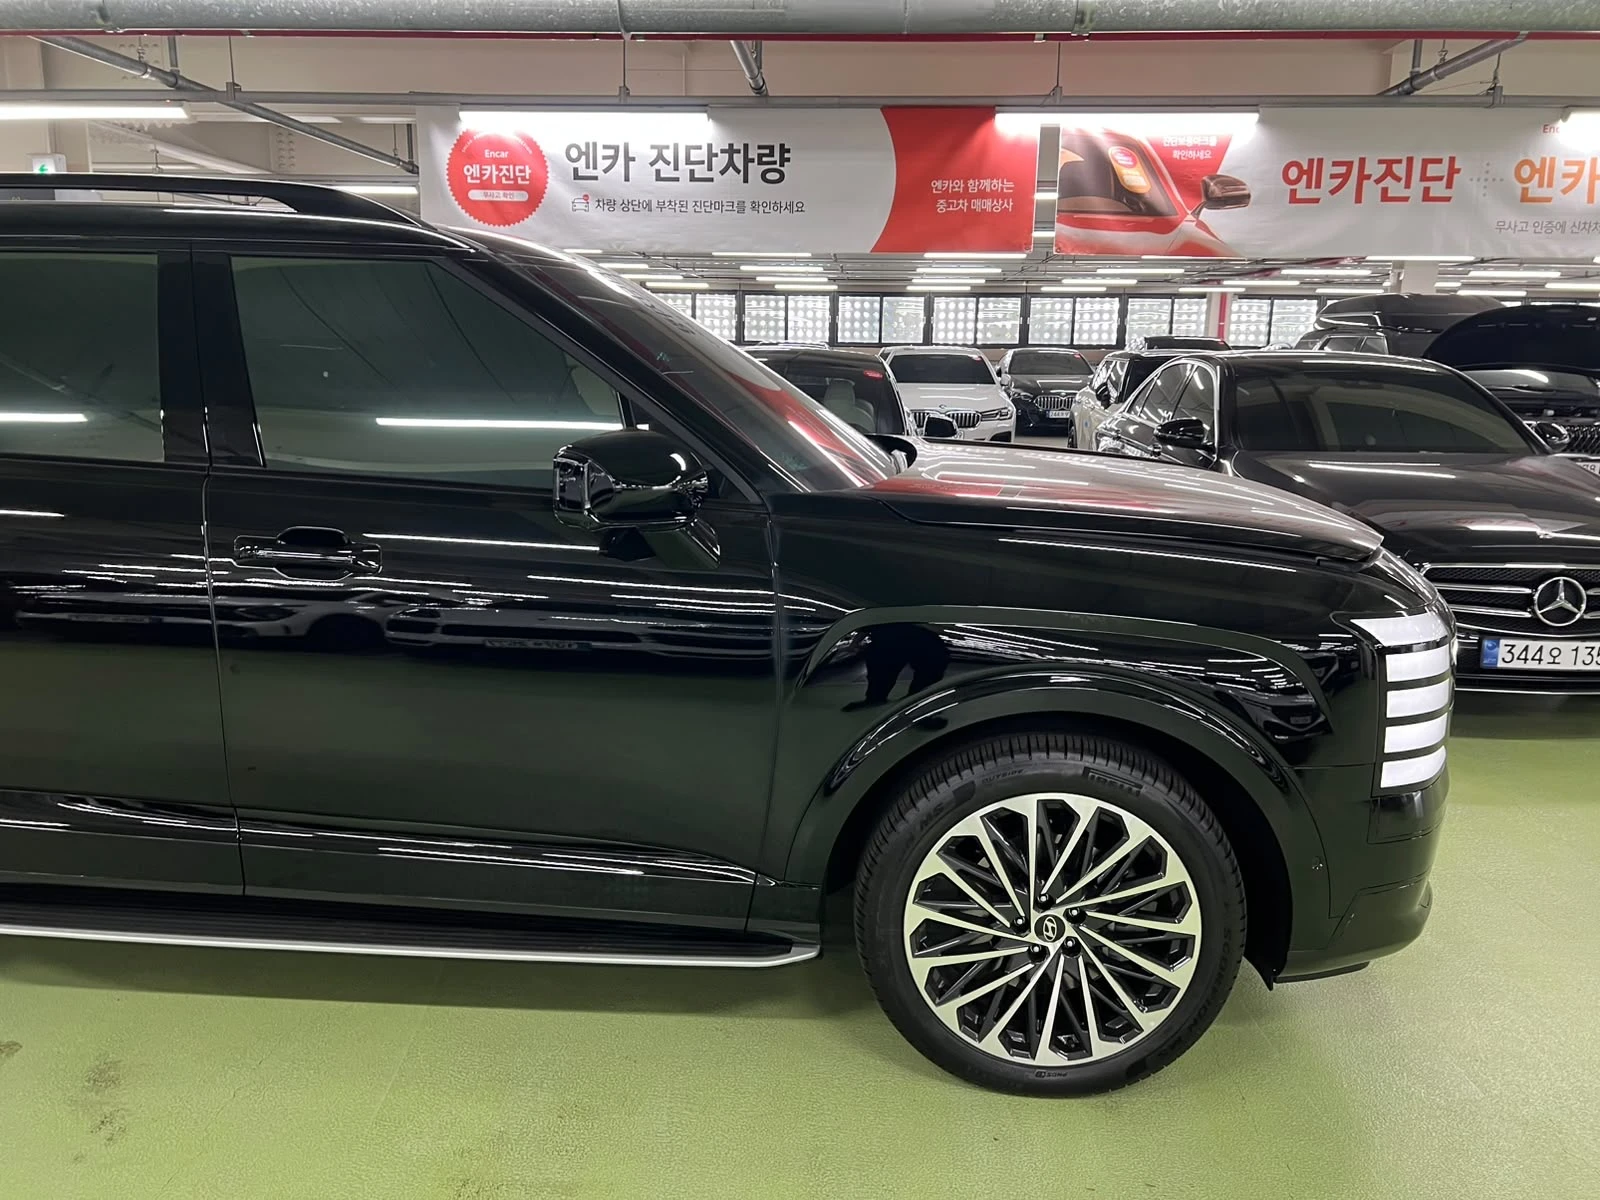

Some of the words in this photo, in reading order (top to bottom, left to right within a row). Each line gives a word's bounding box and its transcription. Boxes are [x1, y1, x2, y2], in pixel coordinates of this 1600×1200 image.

[483, 149, 510, 159] Encar
[1172, 149, 1213, 160] 확인하세요
[564, 142, 636, 182] 엔카
[648, 142, 791, 185] 진단차량
[463, 163, 532, 185] 엔카진단
[1281, 155, 1462, 205] 엔카진단
[930, 178, 964, 194] 엔카와
[967, 178, 1015, 194] 함께하는
[594, 198, 617, 213] 차량
[620, 198, 653, 213] 상단에
[655, 199, 689, 213] 부착된
[691, 199, 747, 214] 진단마크를
[749, 200, 806, 214] 확인하세요
[935, 197, 968, 213] 중고차
[970, 197, 1014, 213] 매매상사
[1495, 220, 1529, 234] 무사고
[1532, 220, 1567, 234] 인증에
[1501, 643, 1562, 665] 344오
